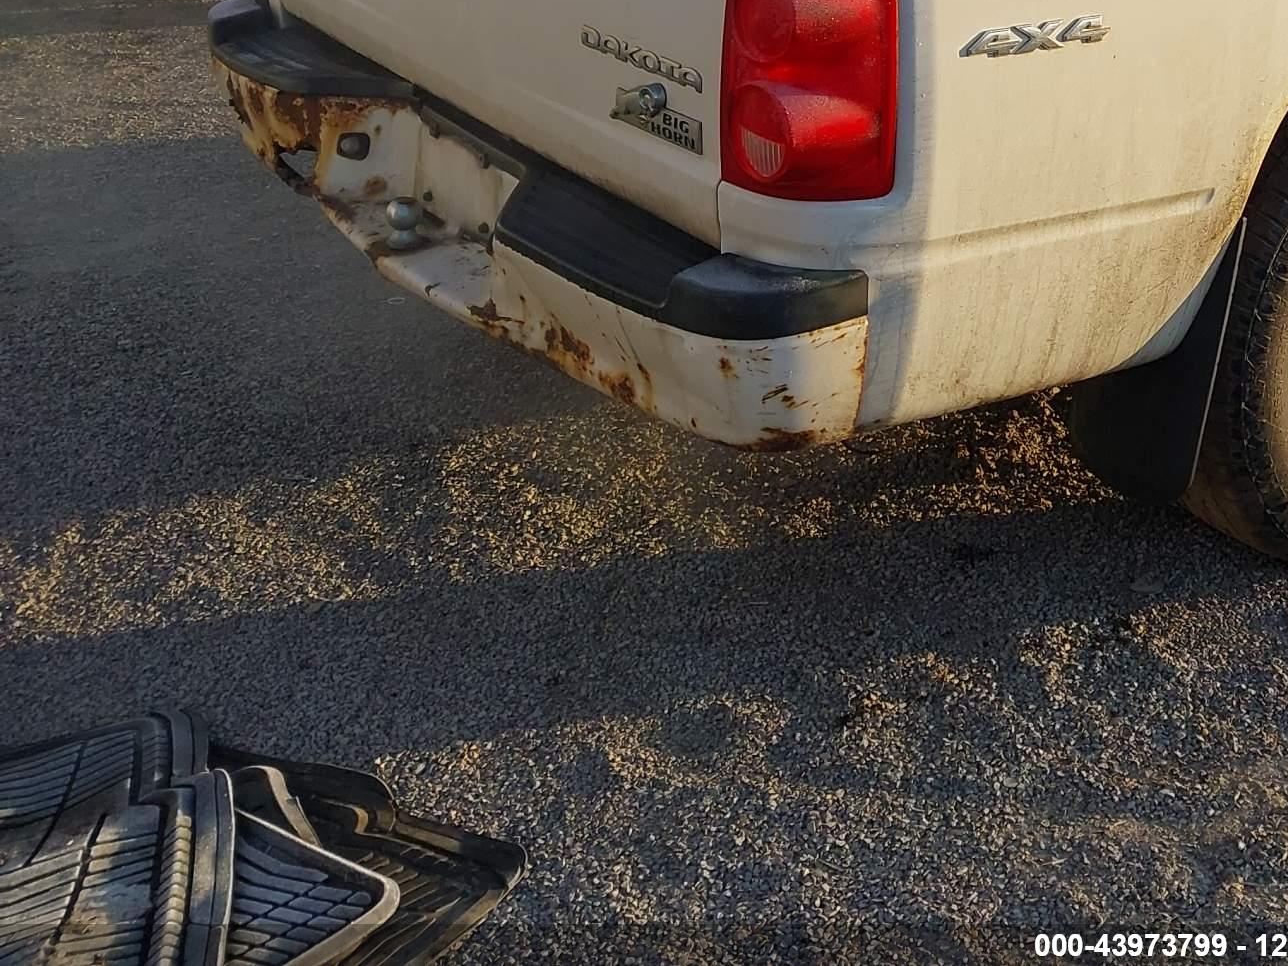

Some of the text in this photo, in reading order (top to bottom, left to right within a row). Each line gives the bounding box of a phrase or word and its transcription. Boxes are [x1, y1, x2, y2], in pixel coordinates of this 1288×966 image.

[580, 24, 703, 94] DAKOTA
[650, 122, 696, 150] HORN
[662, 112, 690, 134] BIG
